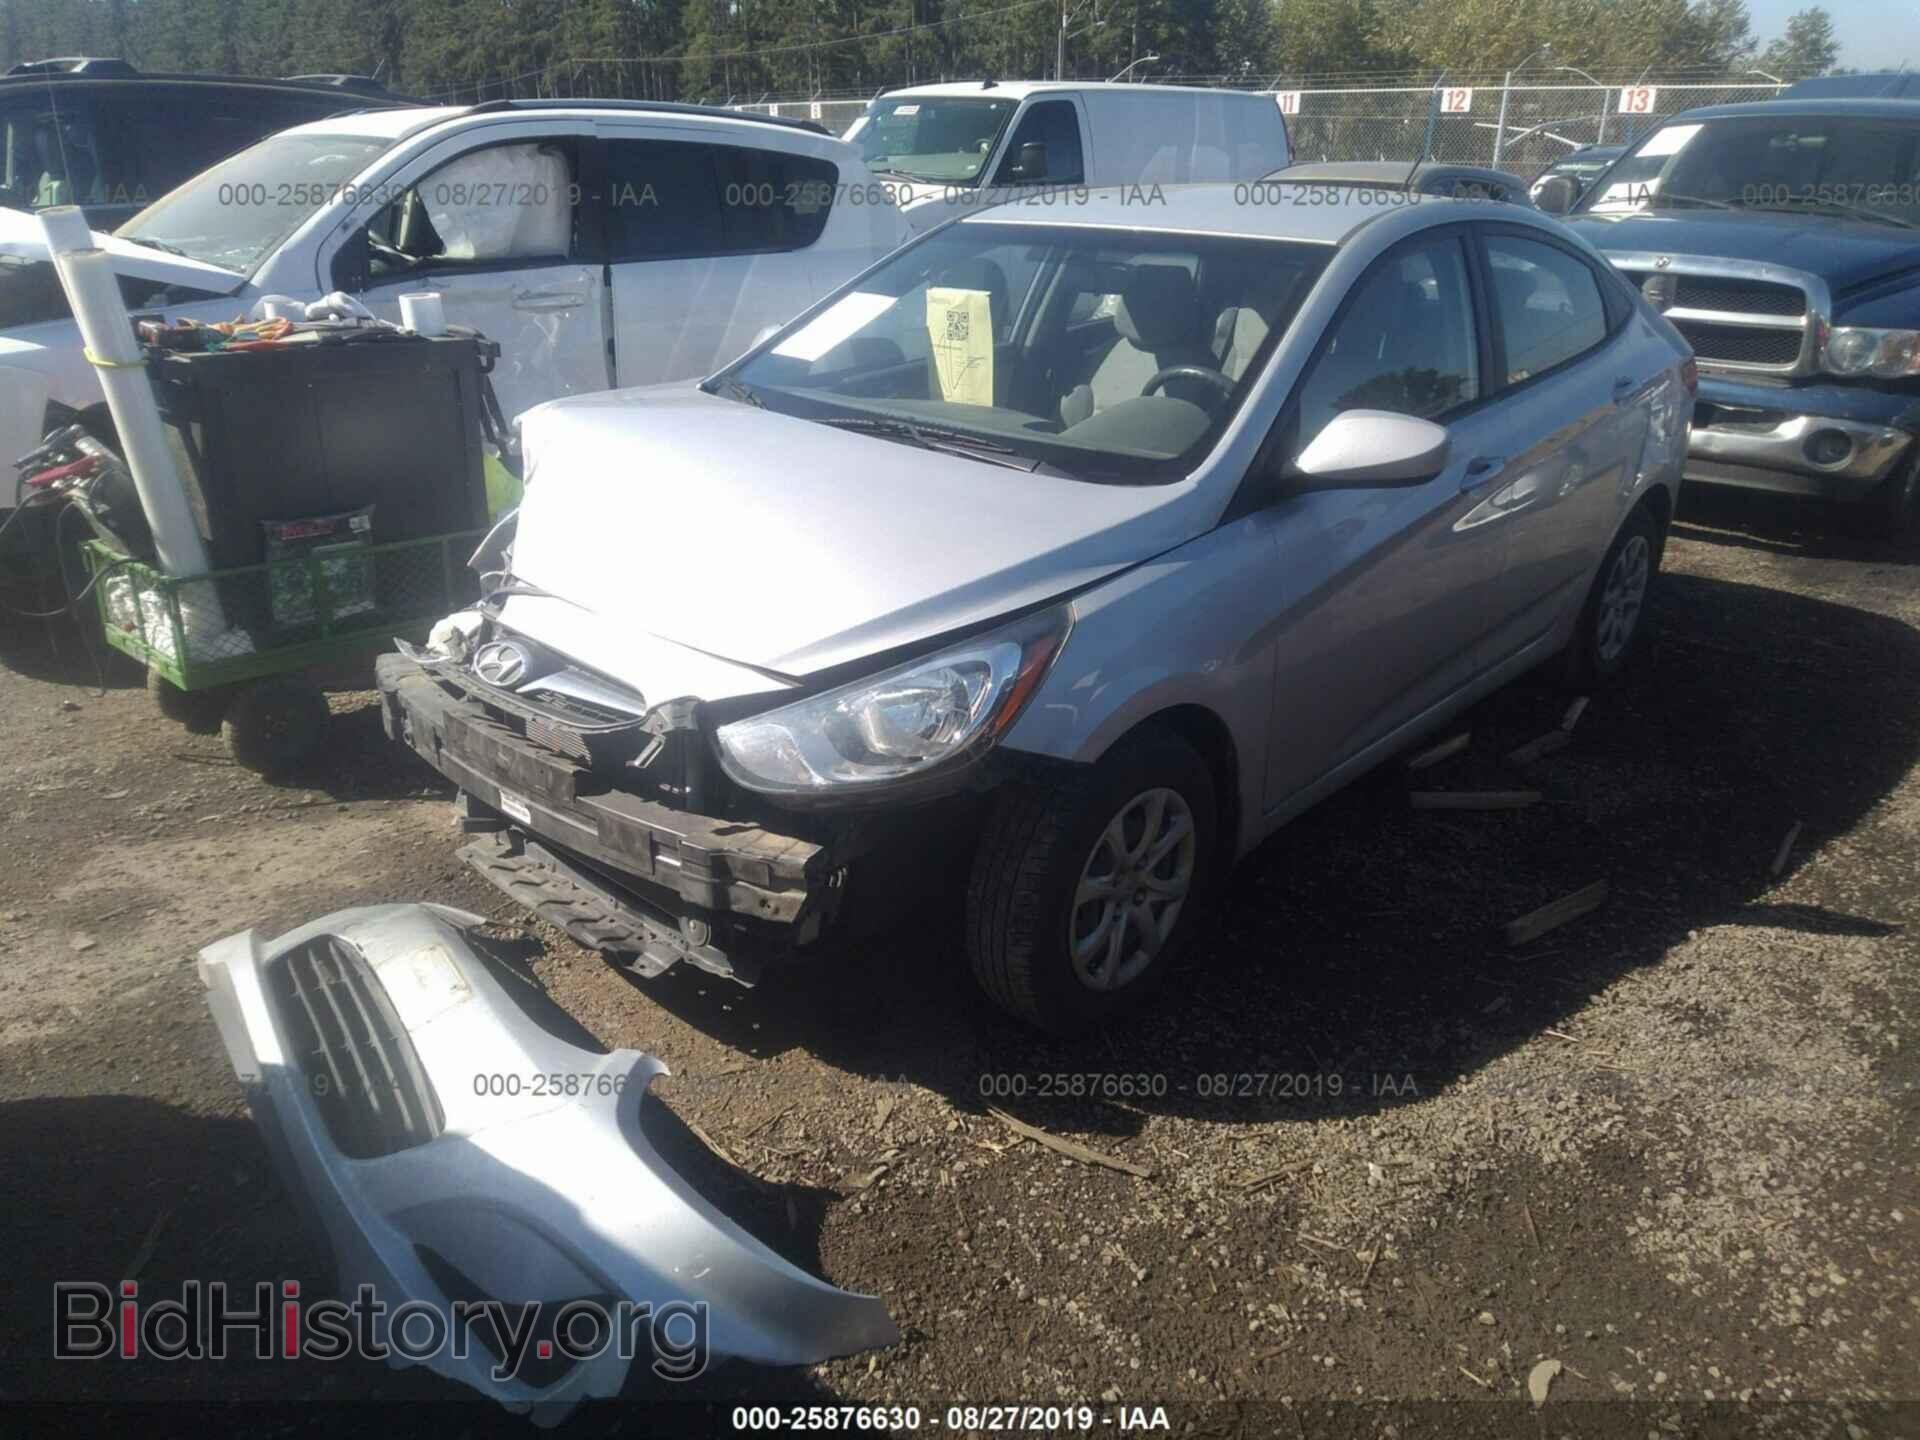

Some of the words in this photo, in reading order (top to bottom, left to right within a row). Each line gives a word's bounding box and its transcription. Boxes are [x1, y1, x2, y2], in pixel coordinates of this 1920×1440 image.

[1281, 94, 1295, 113] 11
[1447, 90, 1466, 111] 12
[1626, 89, 1650, 112] 13
